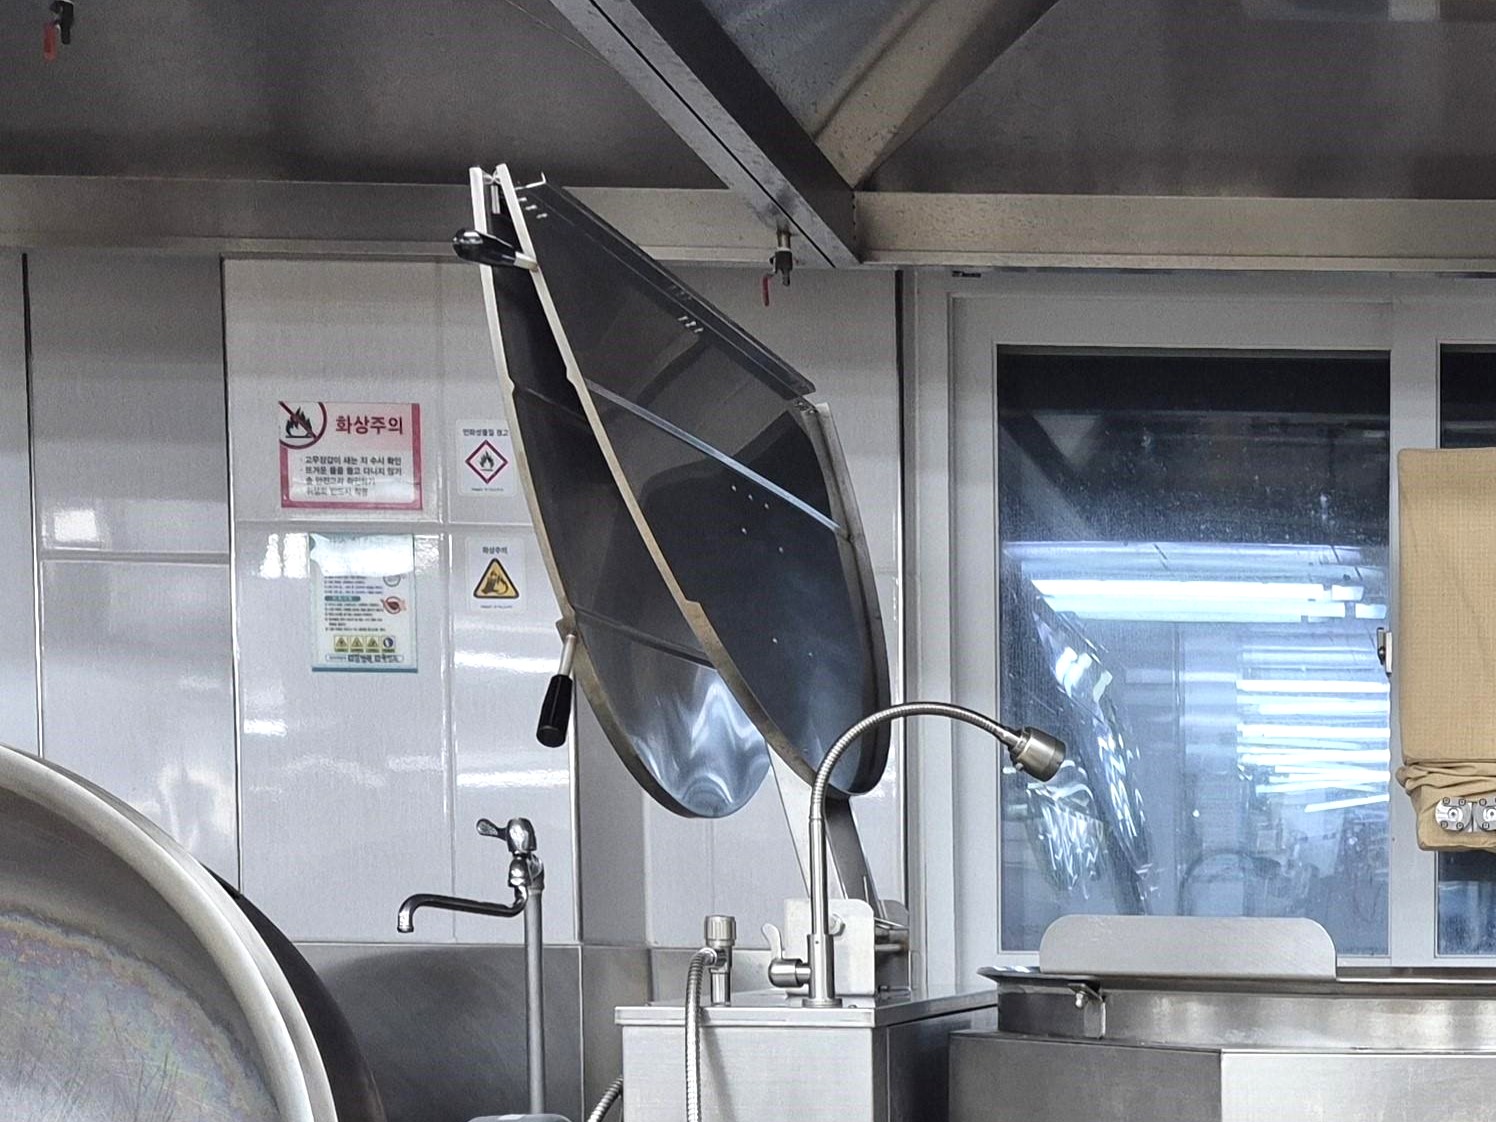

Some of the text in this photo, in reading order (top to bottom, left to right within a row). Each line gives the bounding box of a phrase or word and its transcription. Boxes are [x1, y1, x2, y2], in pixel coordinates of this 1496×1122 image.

[336, 414, 403, 435] 화상주의
[305, 456, 341, 465] 고무장갑이
[370, 456, 384, 465] 수시
[387, 456, 401, 466] 확인
[305, 466, 327, 475] 뜨거운
[363, 467, 385, 476] 다니지
